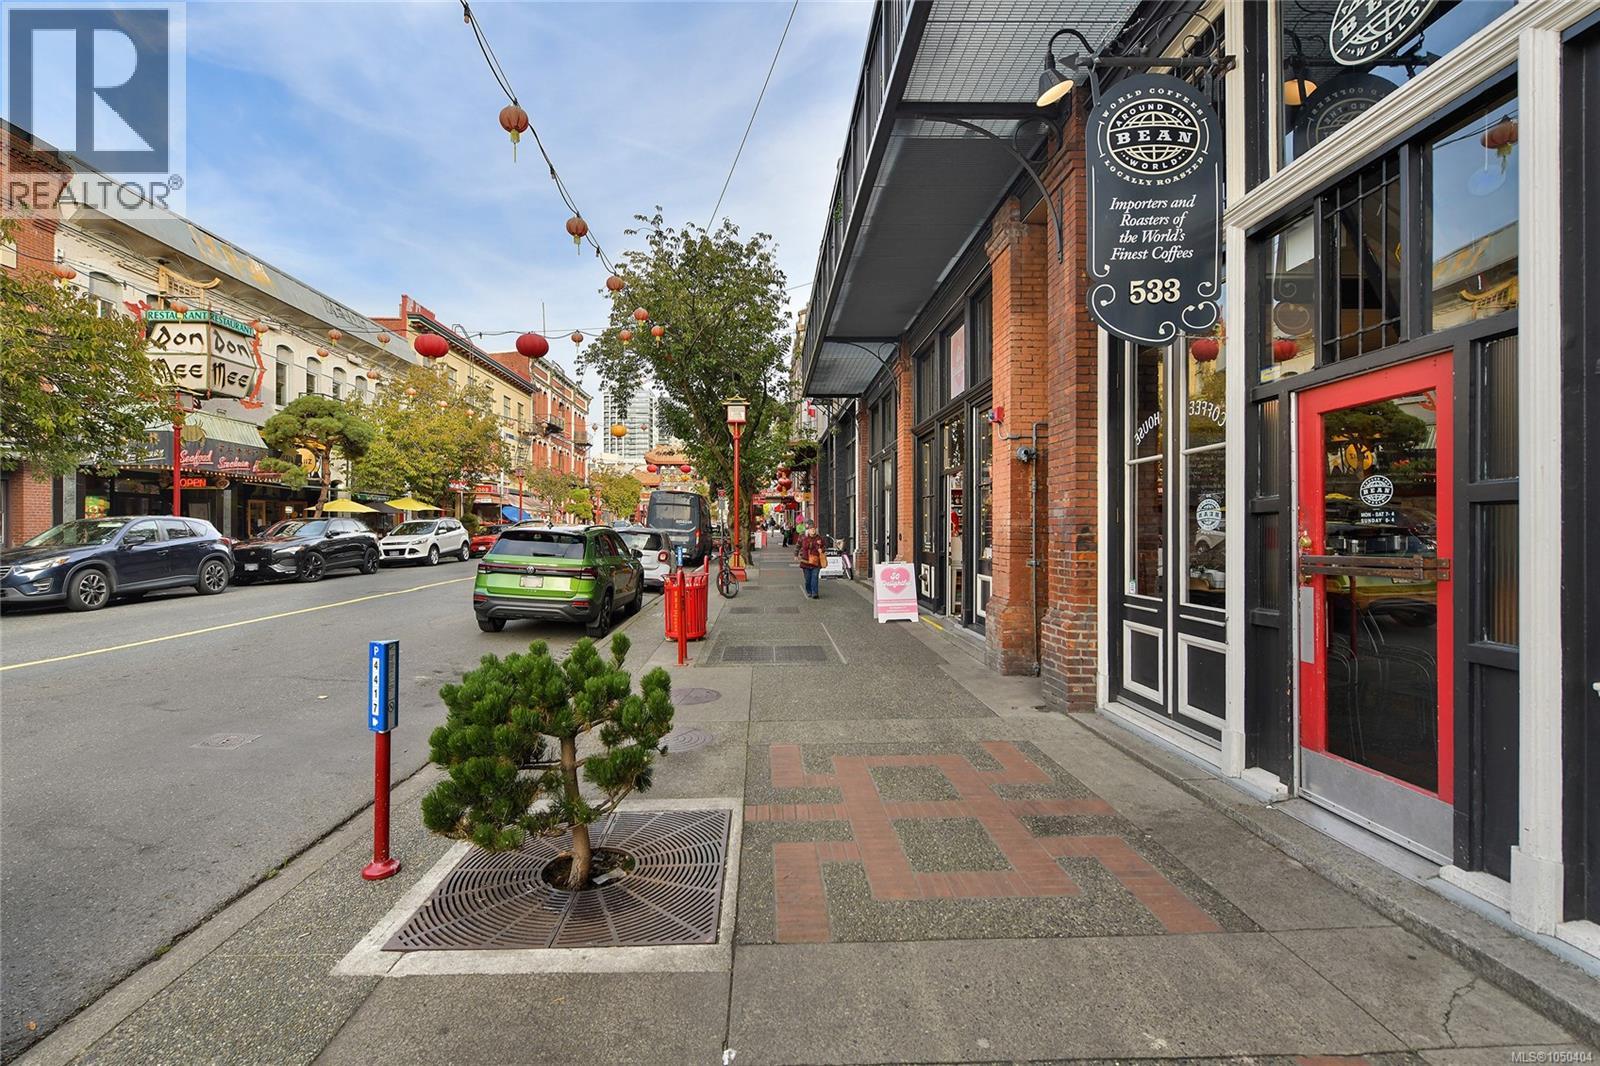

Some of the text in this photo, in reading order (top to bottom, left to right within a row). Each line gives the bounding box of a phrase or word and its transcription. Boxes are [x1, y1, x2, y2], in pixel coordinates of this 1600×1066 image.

[1102, 88, 1203, 118] WORLD COFFEES
[1115, 103, 1191, 127] AROUND THE
[1115, 129, 1193, 145] BEAN
[1104, 156, 1204, 186] LOCALLY ROASTED
[1109, 194, 1197, 213] Importers and
[1119, 211, 1189, 229] Roasters of
[1119, 227, 1186, 243] the World's
[1110, 245, 1194, 263] Finest Coffees
[1129, 278, 1181, 304] 533
[210, 313, 253, 335] RESTAURANT
[151, 326, 204, 350] Don
[213, 329, 250, 358] Don
[179, 478, 206, 487] OPEN
[1363, 487, 1390, 495] BEAN
